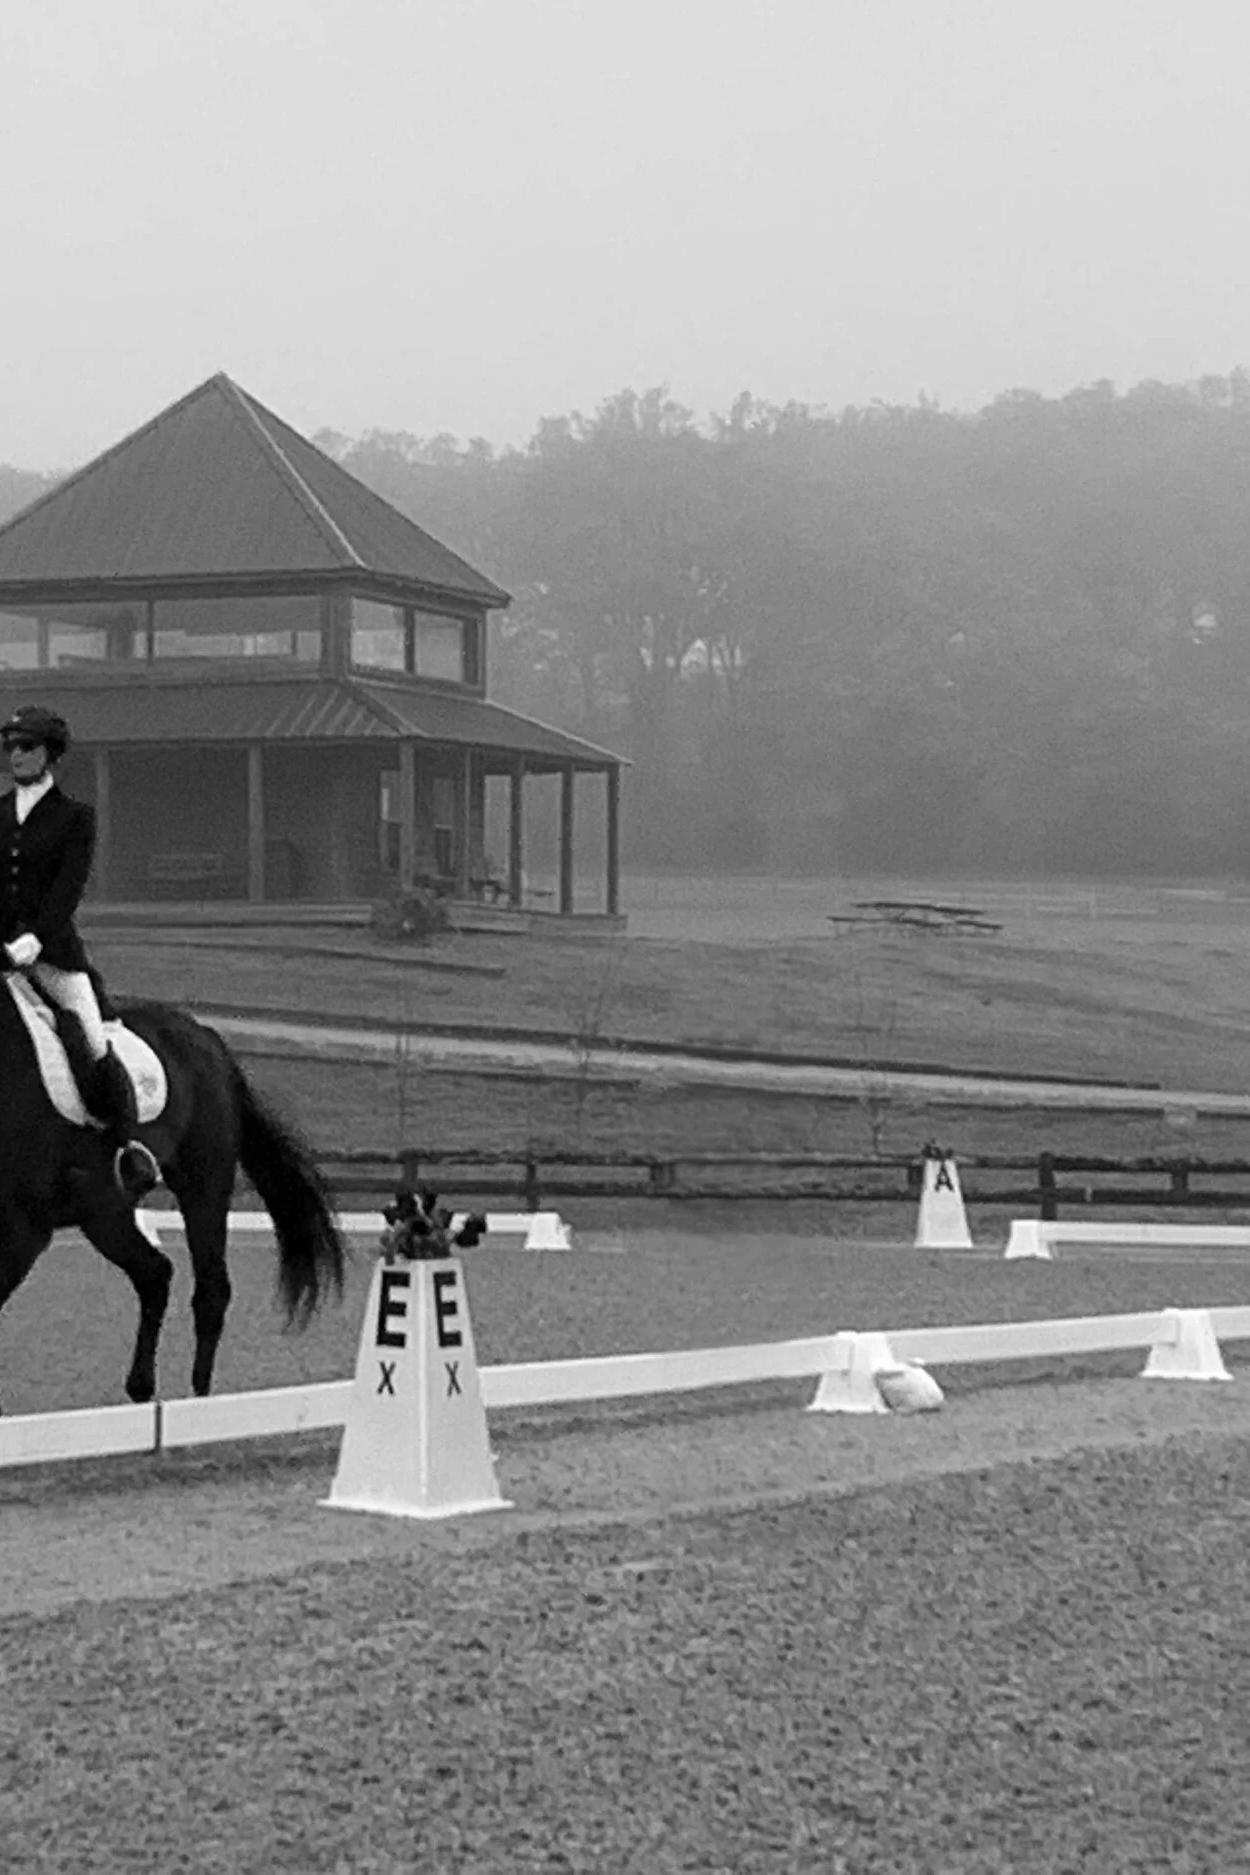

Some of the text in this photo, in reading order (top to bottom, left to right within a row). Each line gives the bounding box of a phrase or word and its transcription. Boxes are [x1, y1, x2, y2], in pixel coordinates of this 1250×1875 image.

[934, 1164, 954, 1192] A
[376, 1269, 411, 1349] E
[432, 1269, 463, 1349] E
